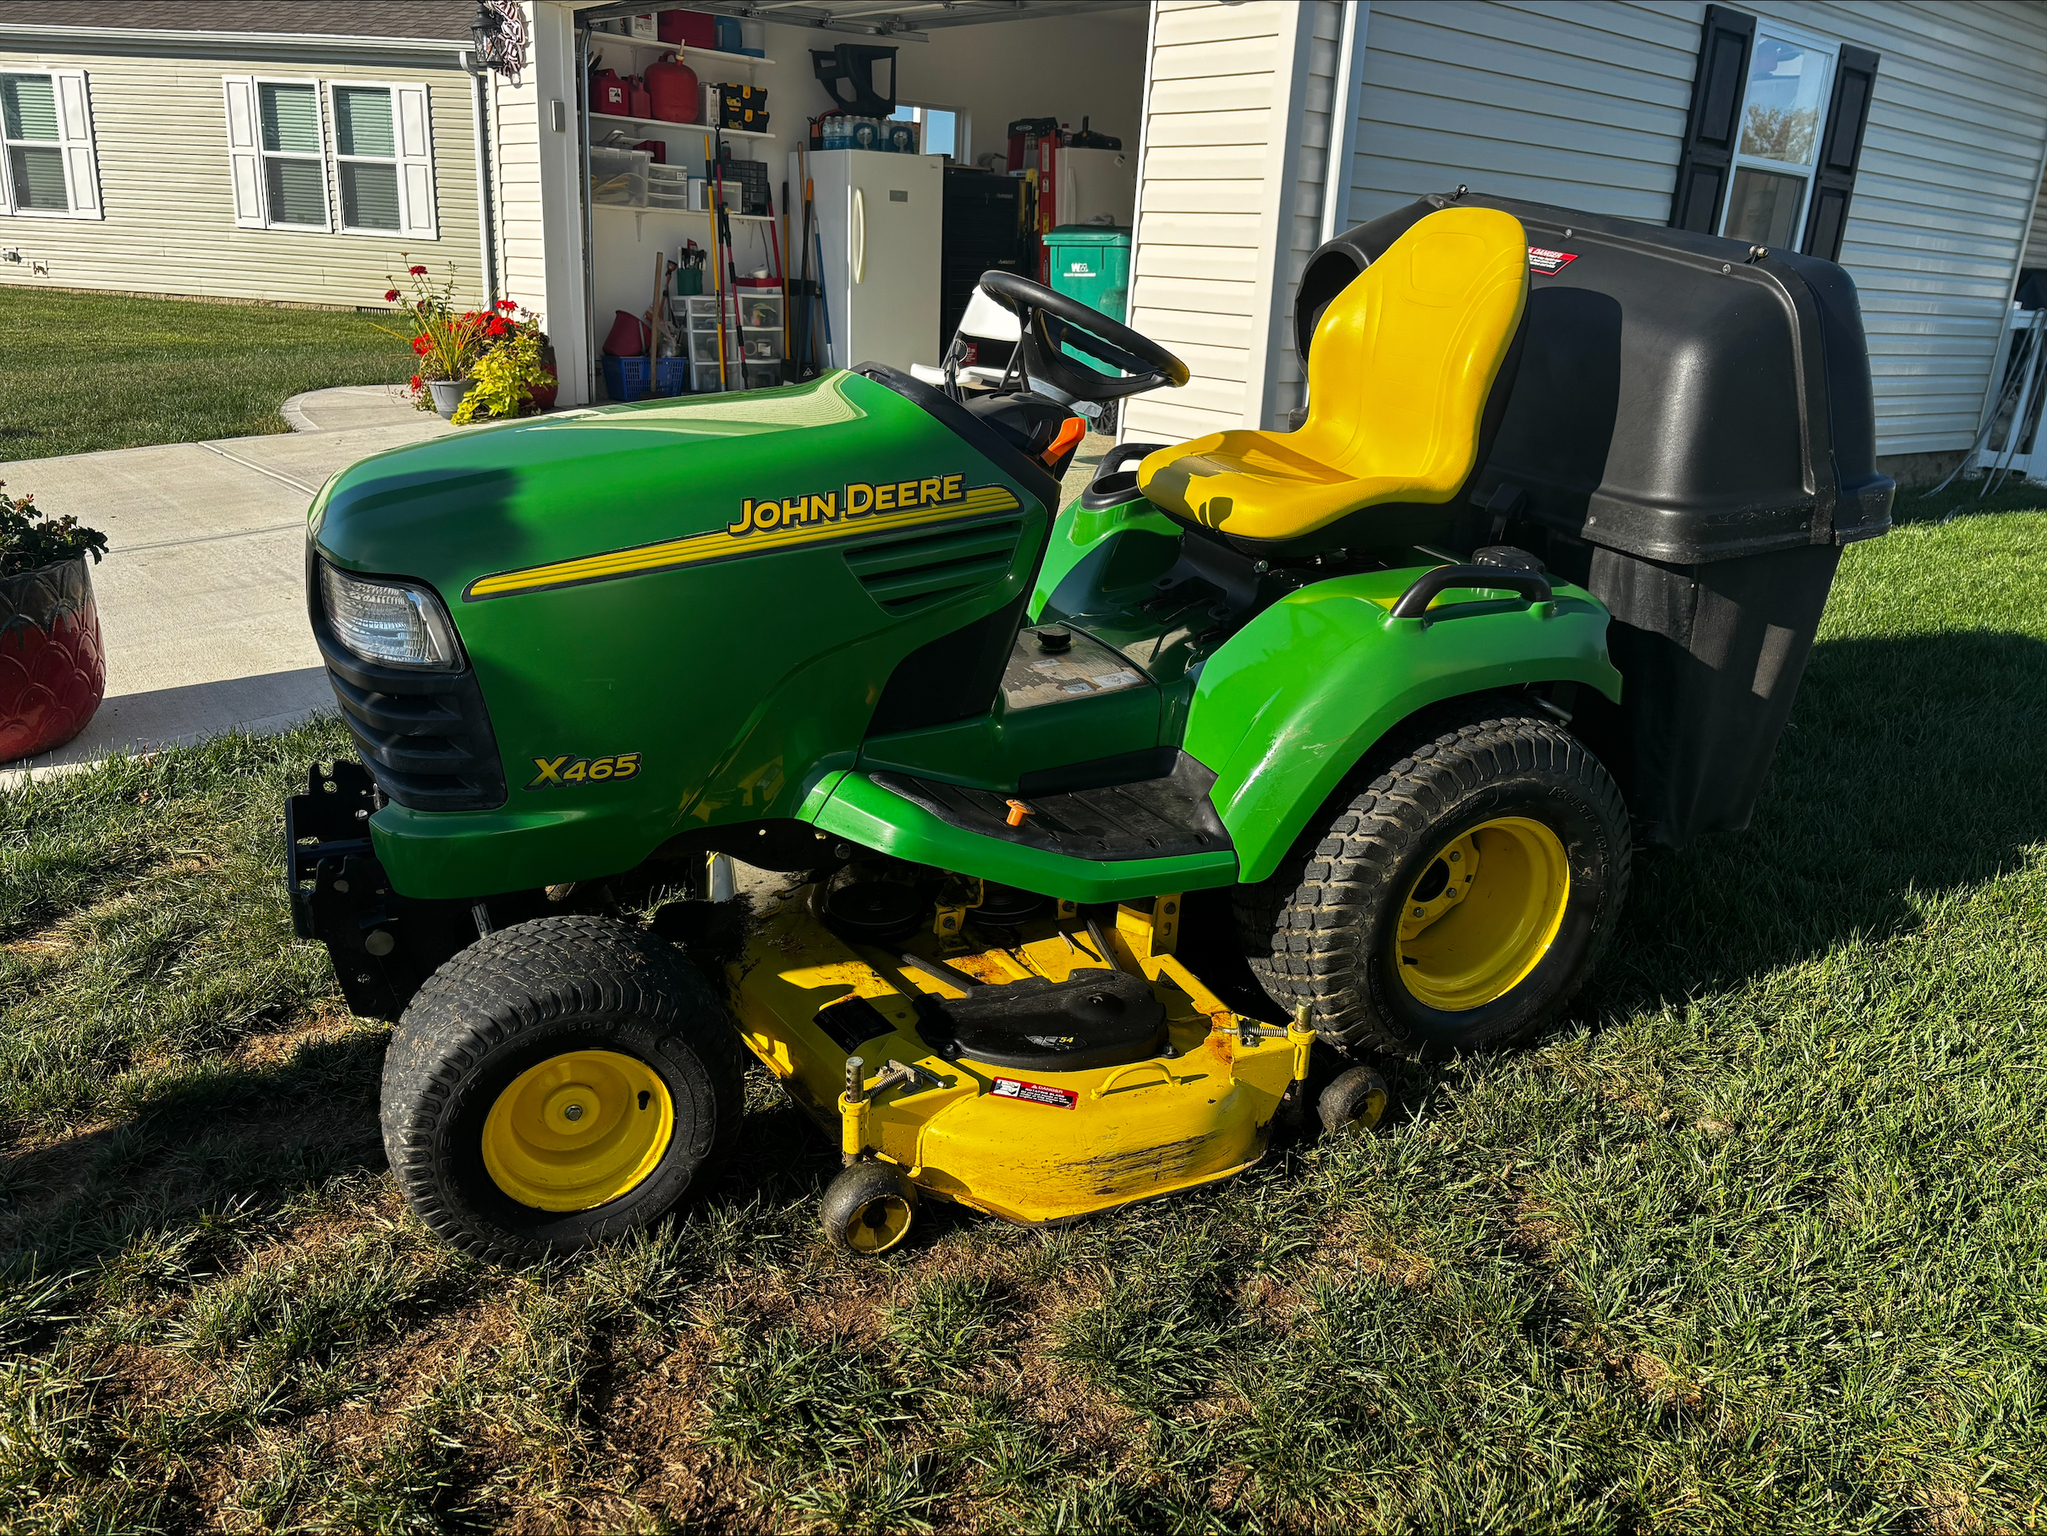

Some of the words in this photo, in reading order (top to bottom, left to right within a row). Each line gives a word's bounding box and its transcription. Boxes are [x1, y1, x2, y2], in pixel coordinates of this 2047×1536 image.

[1532, 248, 1564, 259] DANGER
[727, 491, 842, 538] JOHN
[844, 472, 967, 519] DEERE
[520, 752, 643, 791] X465
[1548, 786, 1597, 824] MULTI
[1059, 1036, 1074, 1044] 54
[1037, 1084, 1064, 1095] DANGER
